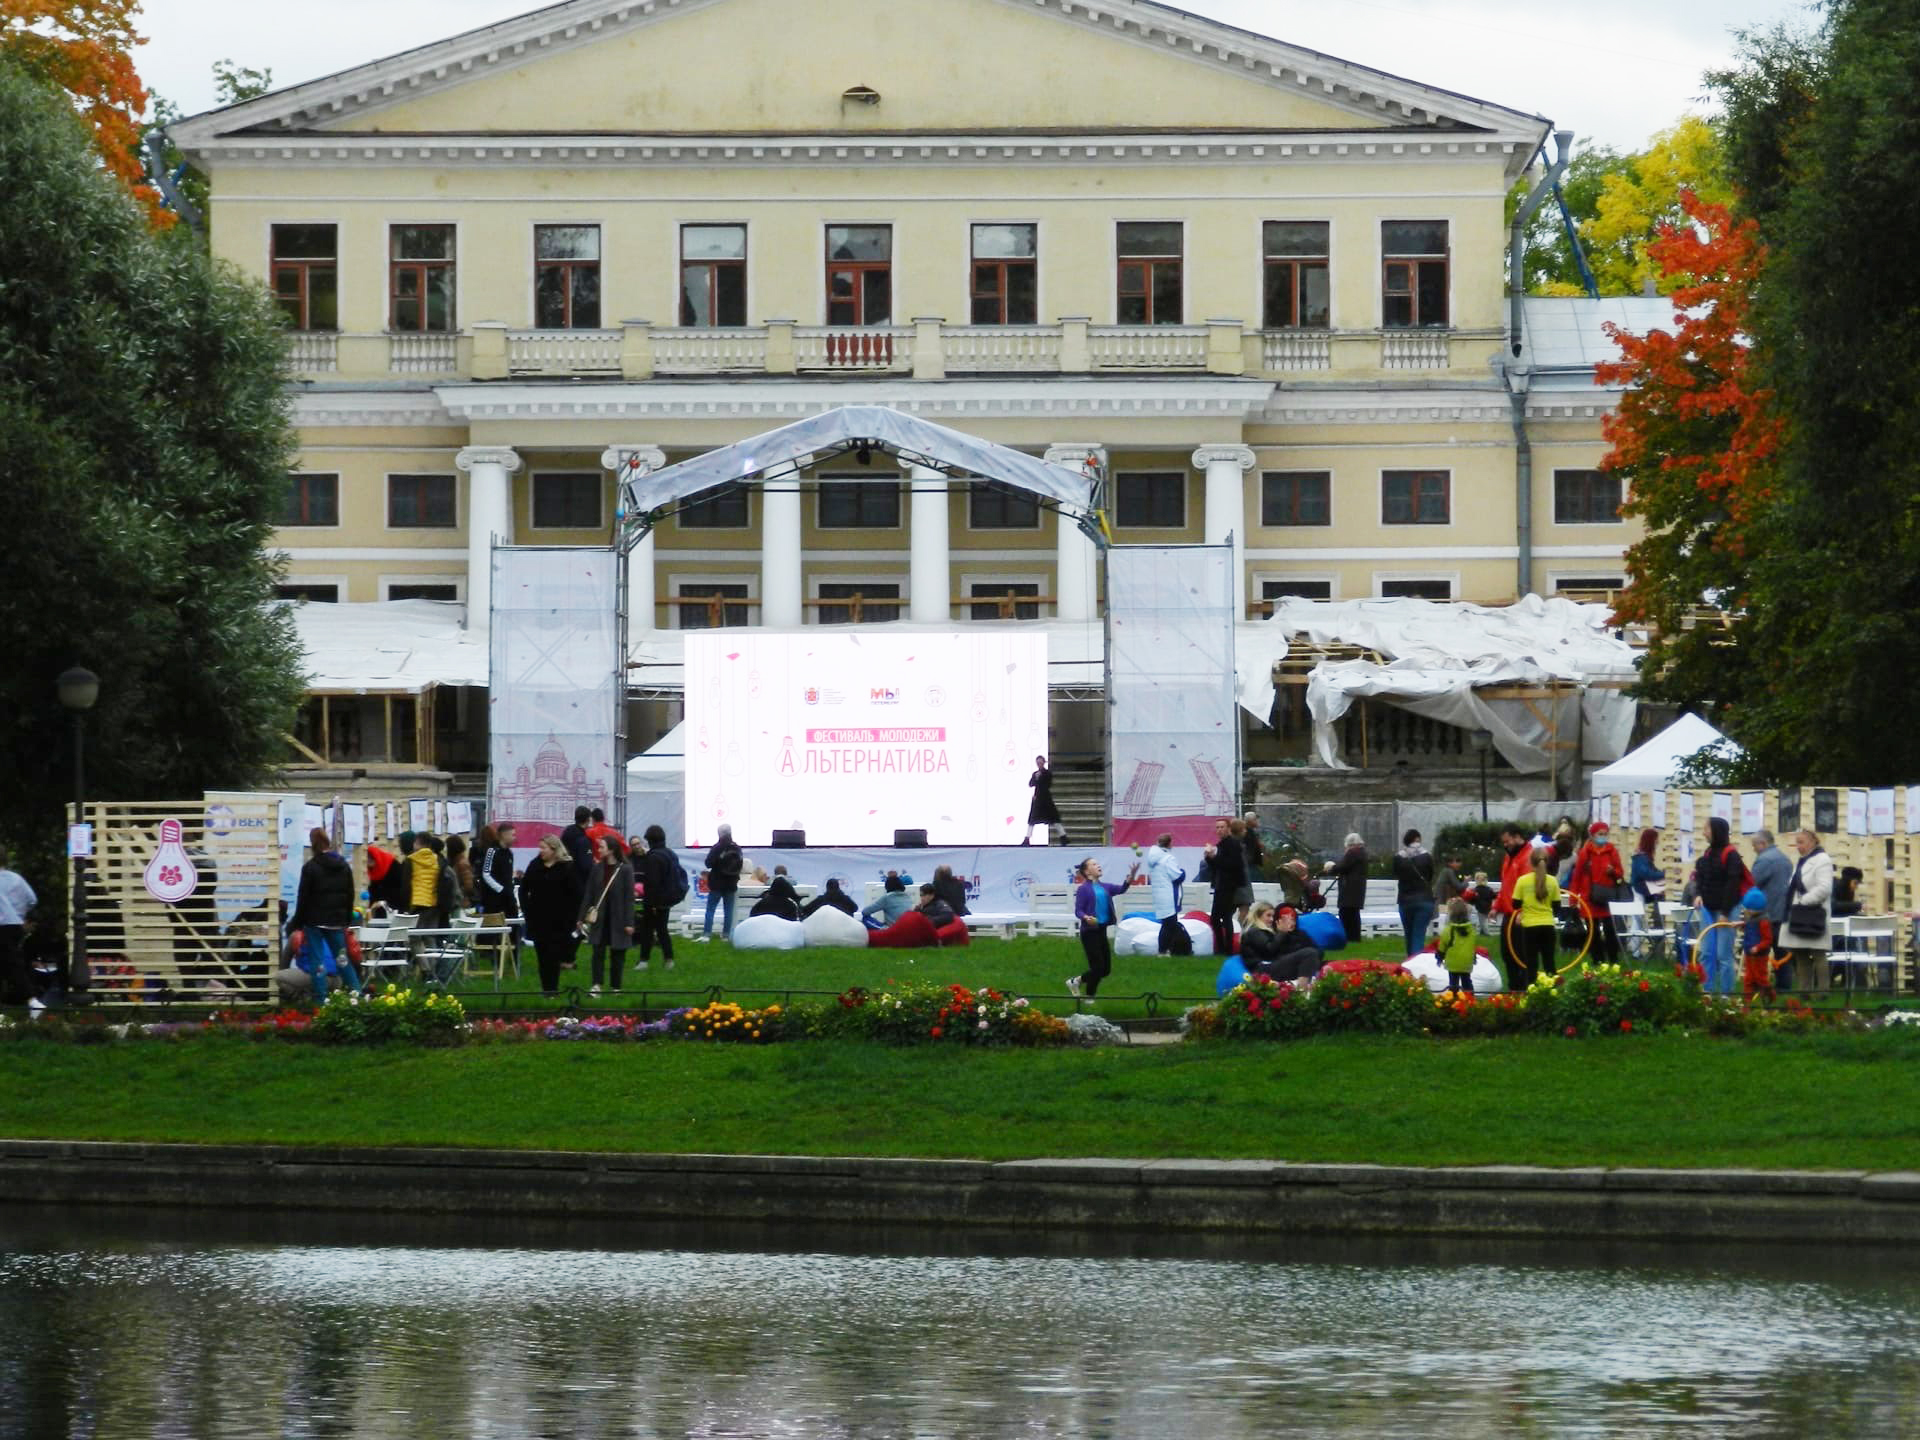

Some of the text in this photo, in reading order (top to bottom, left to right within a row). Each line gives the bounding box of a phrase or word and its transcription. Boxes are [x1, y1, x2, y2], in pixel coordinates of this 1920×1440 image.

[813, 729, 939, 742] ФЕСТИВАЛЬ МОЛОДЕЖИ
[781, 749, 950, 773] АЛЬТЕРНАТИВА
